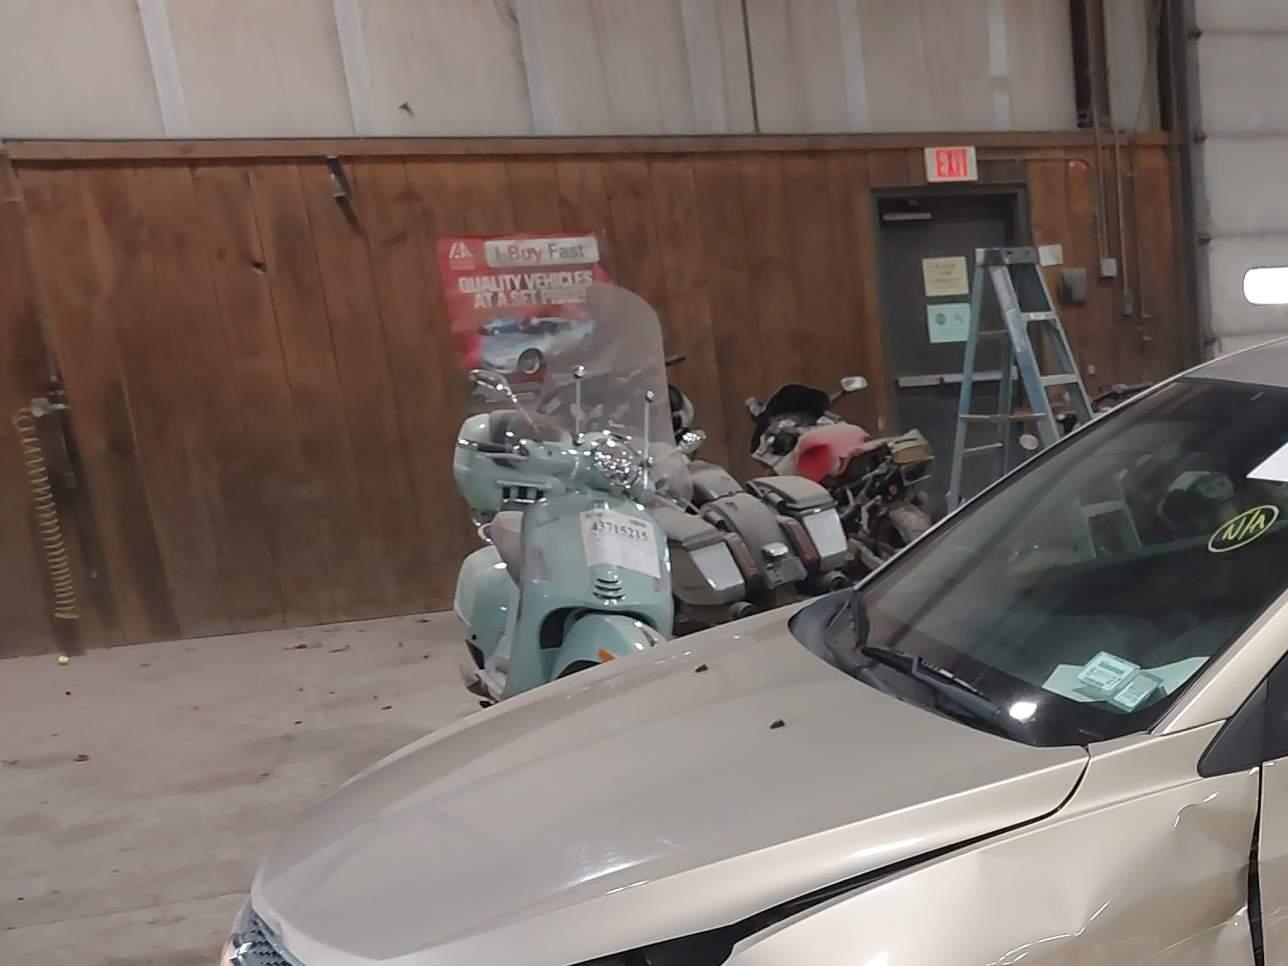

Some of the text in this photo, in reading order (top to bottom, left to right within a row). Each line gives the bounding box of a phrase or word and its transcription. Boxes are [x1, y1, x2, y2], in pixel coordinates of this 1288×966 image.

[935, 149, 968, 177] EXIT
[548, 242, 585, 259] Fast
[458, 270, 593, 294] QUALITY VEHICLES
[474, 292, 494, 309] AT
[498, 291, 509, 308] A
[511, 289, 537, 306] SET
[591, 520, 649, 541] 43715215
